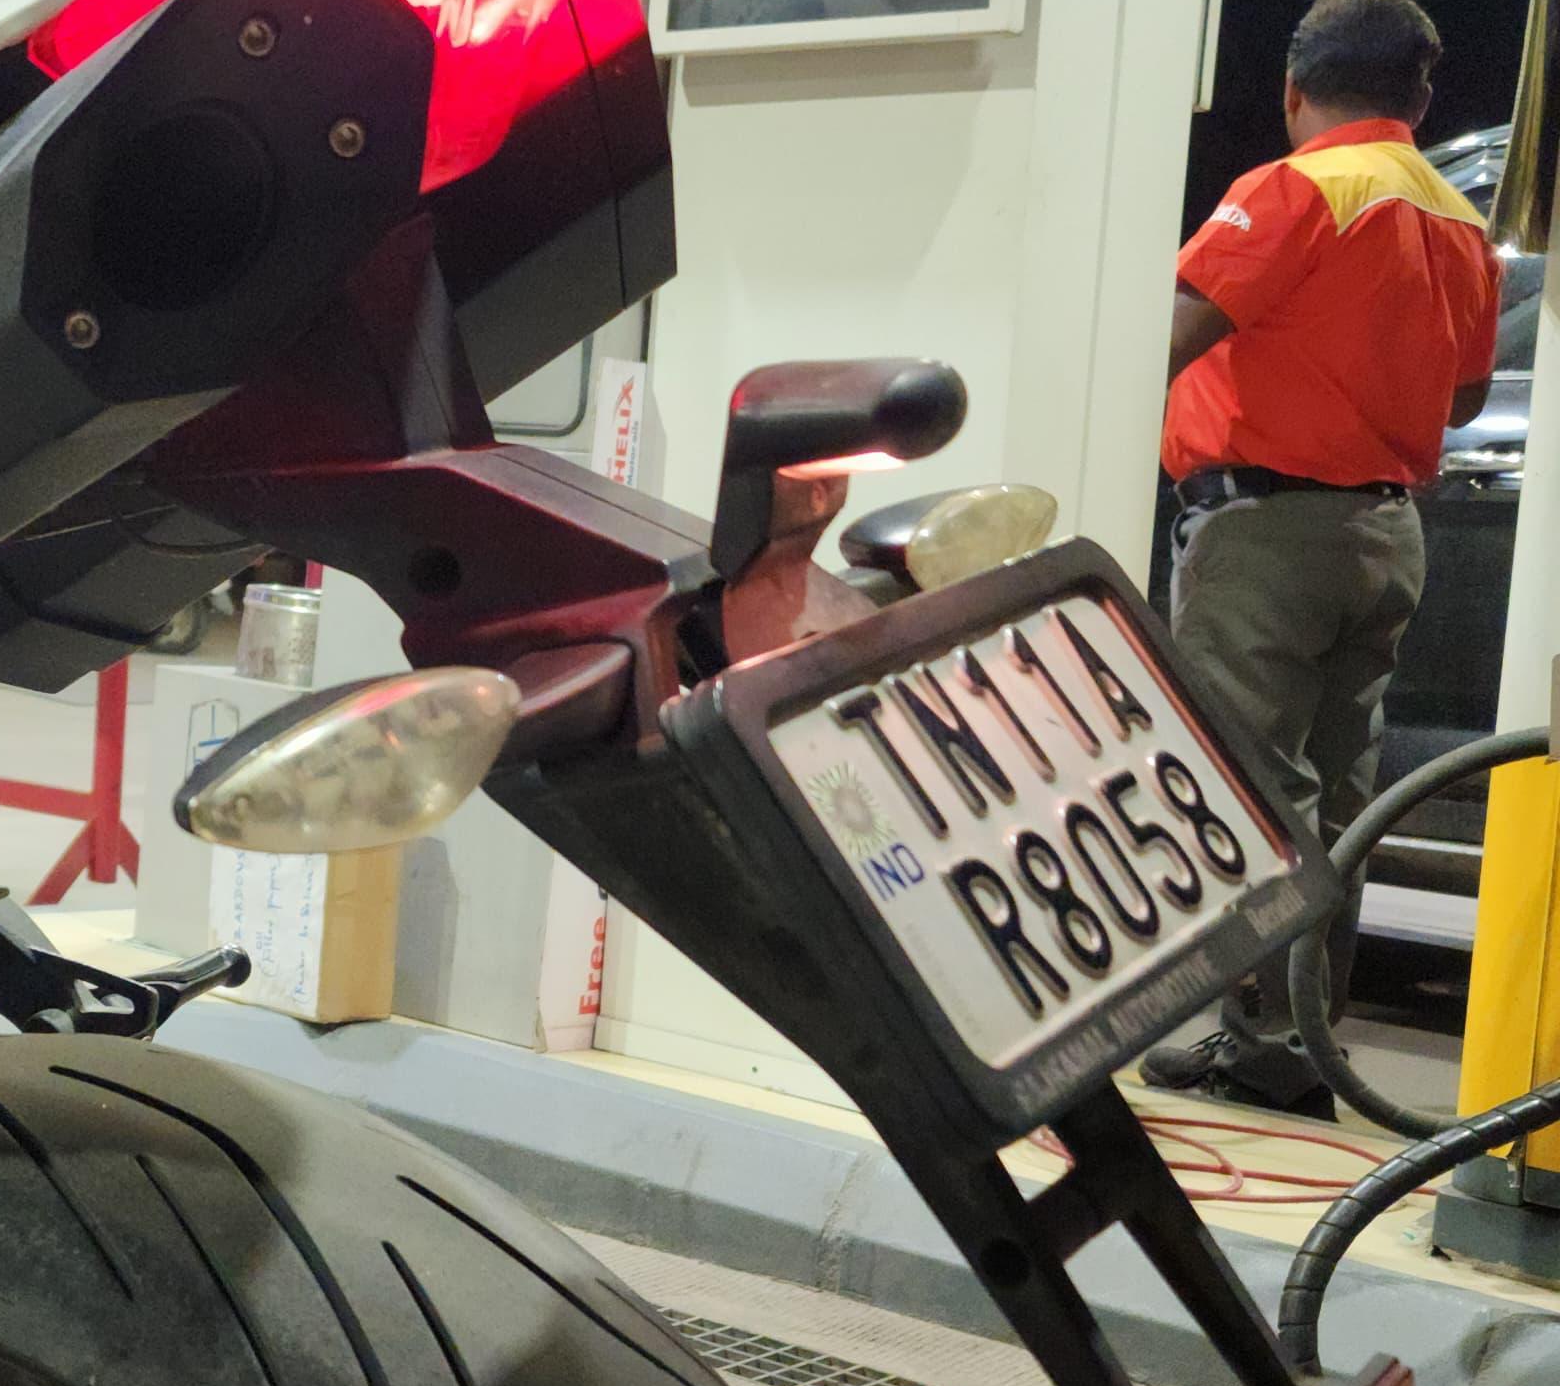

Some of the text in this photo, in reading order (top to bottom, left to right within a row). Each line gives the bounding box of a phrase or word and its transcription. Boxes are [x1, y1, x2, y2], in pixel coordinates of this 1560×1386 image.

[613, 376, 634, 484] HELIX
[824, 606, 1152, 840] TN11A
[861, 843, 925, 902] IND
[943, 750, 1246, 1014] R8058
[578, 916, 605, 1016] Free
